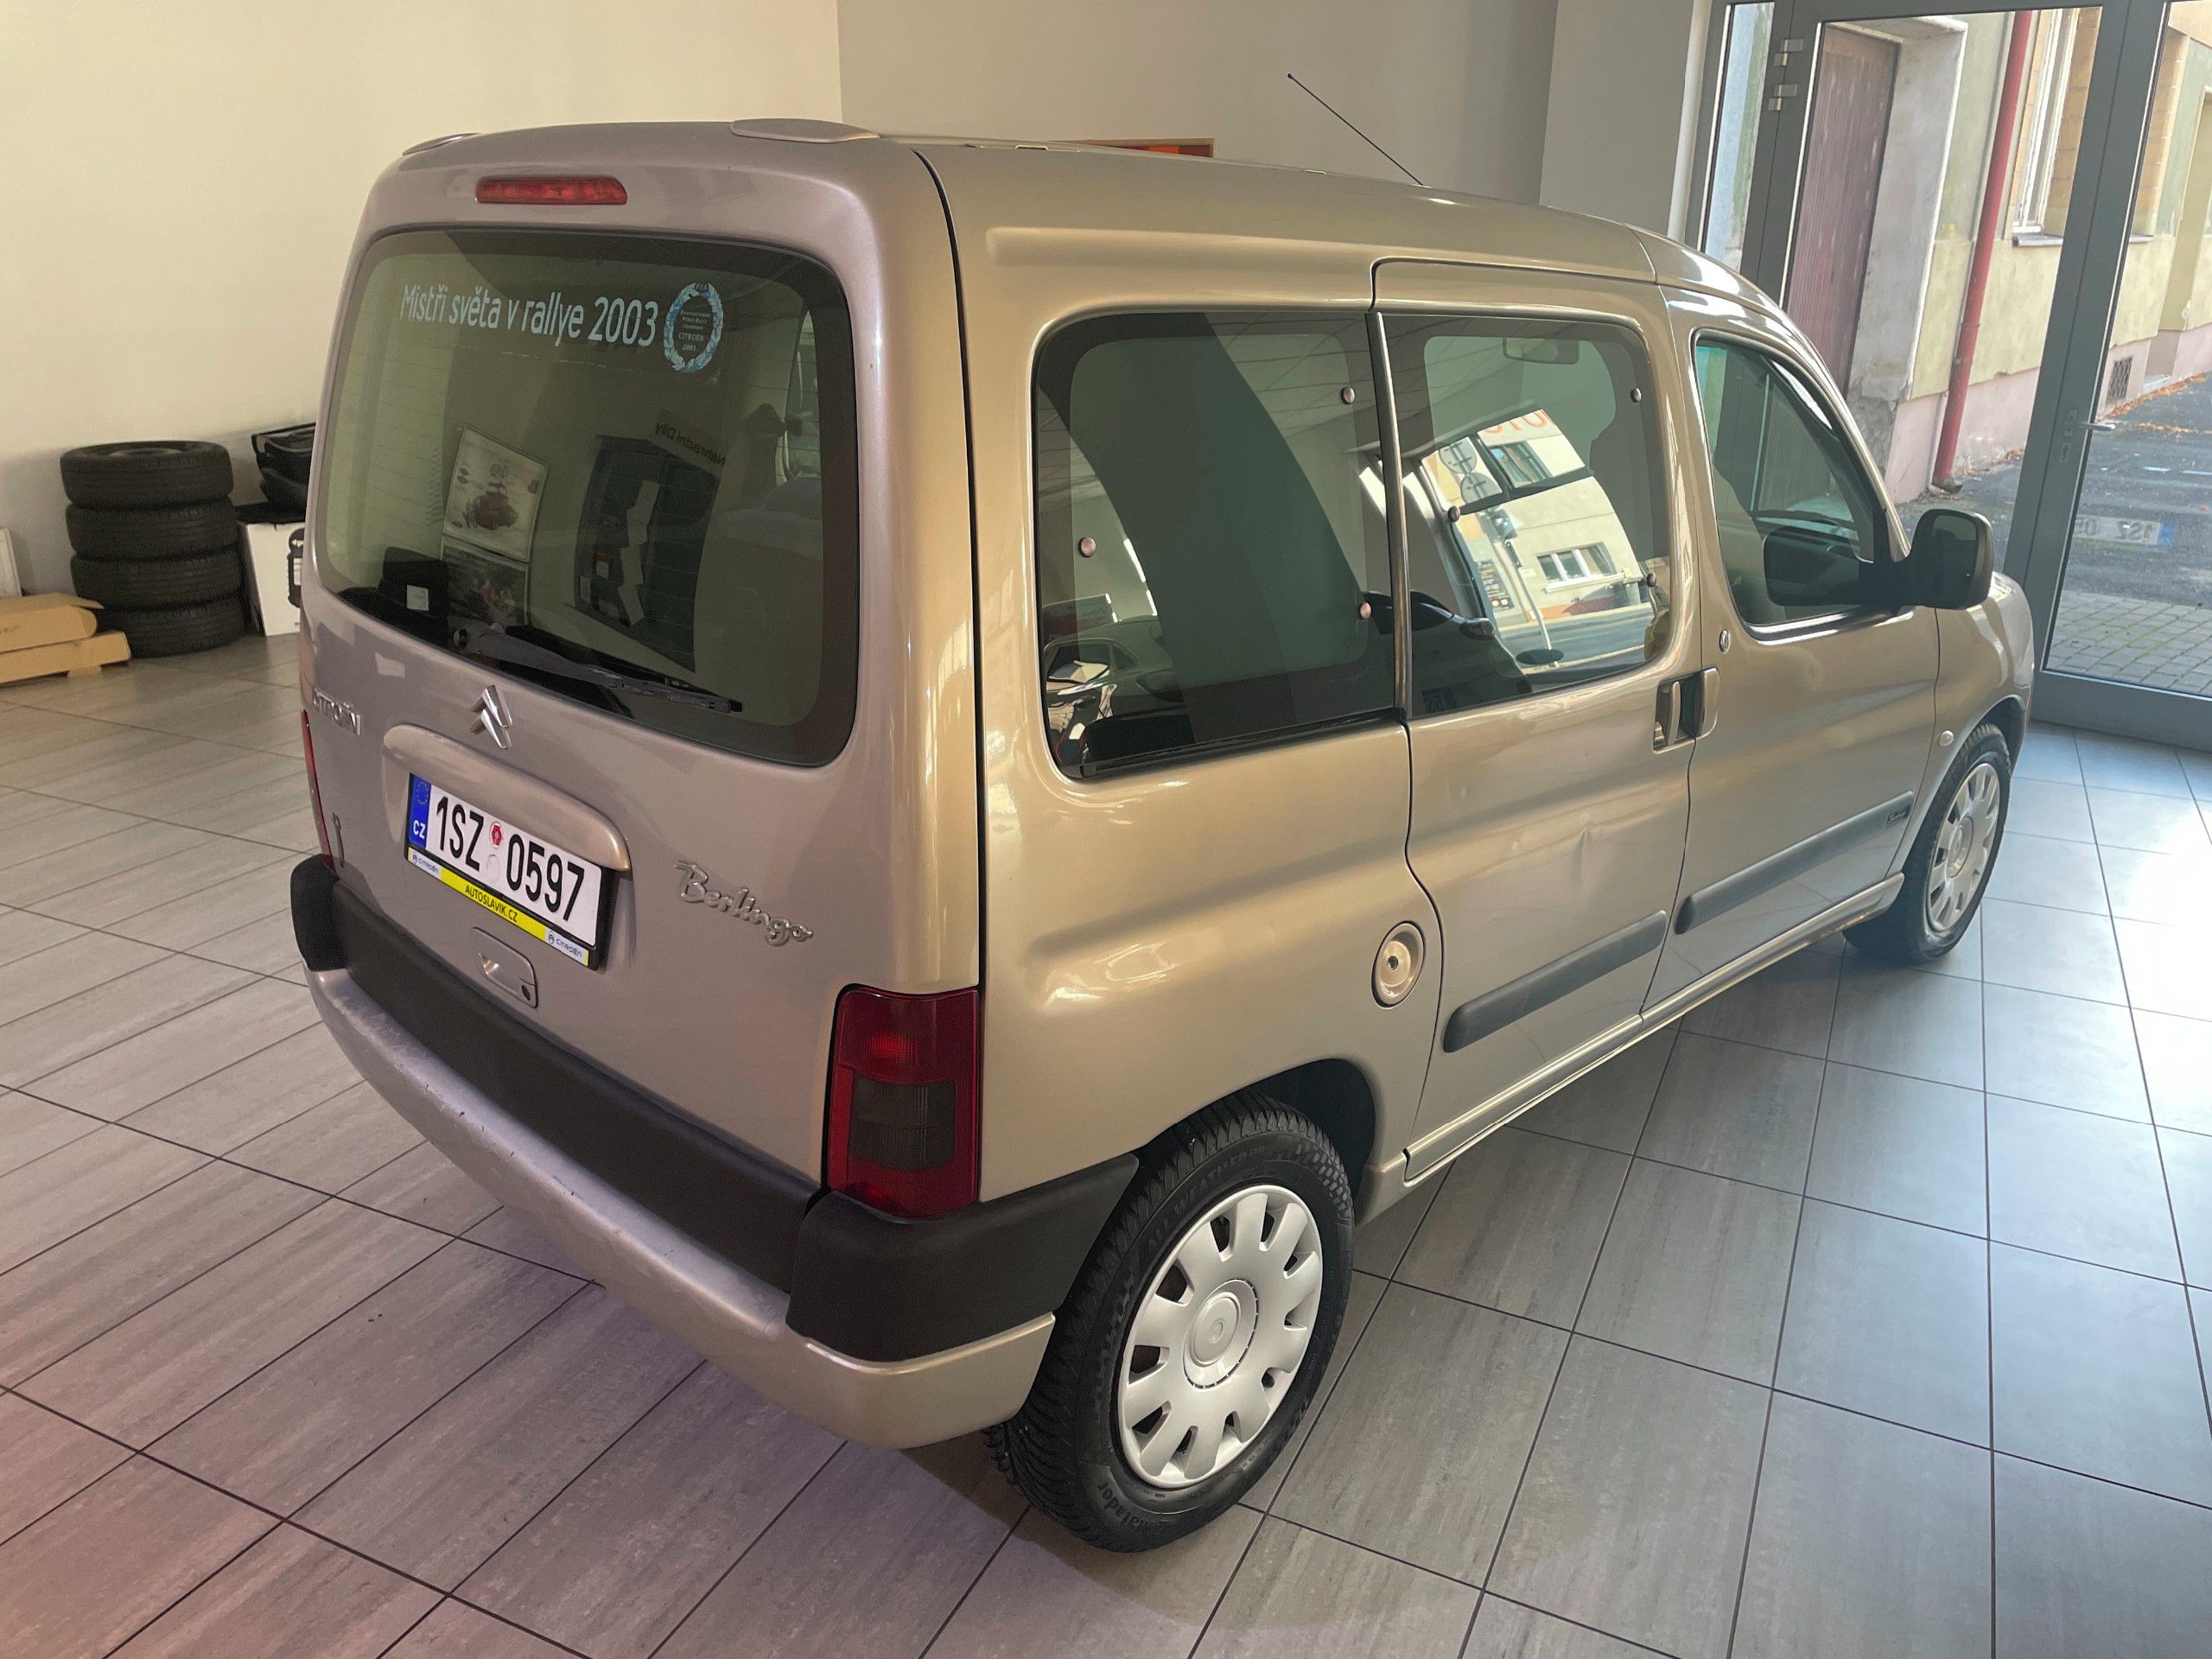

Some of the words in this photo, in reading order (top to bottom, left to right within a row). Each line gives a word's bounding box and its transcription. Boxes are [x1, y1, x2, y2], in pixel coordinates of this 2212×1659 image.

[399, 283, 448, 322] Mistři
[448, 286, 502, 329] světa
[506, 299, 520, 330] v
[520, 292, 585, 346] rallye
[587, 296, 659, 346] 2003
[413, 819, 426, 840] CZ
[435, 796, 485, 872] 1SZ
[505, 833, 585, 922] 0597
[465, 884, 518, 924] AUTOSLAVIK.CZ
[673, 860, 814, 947] Berlingo
